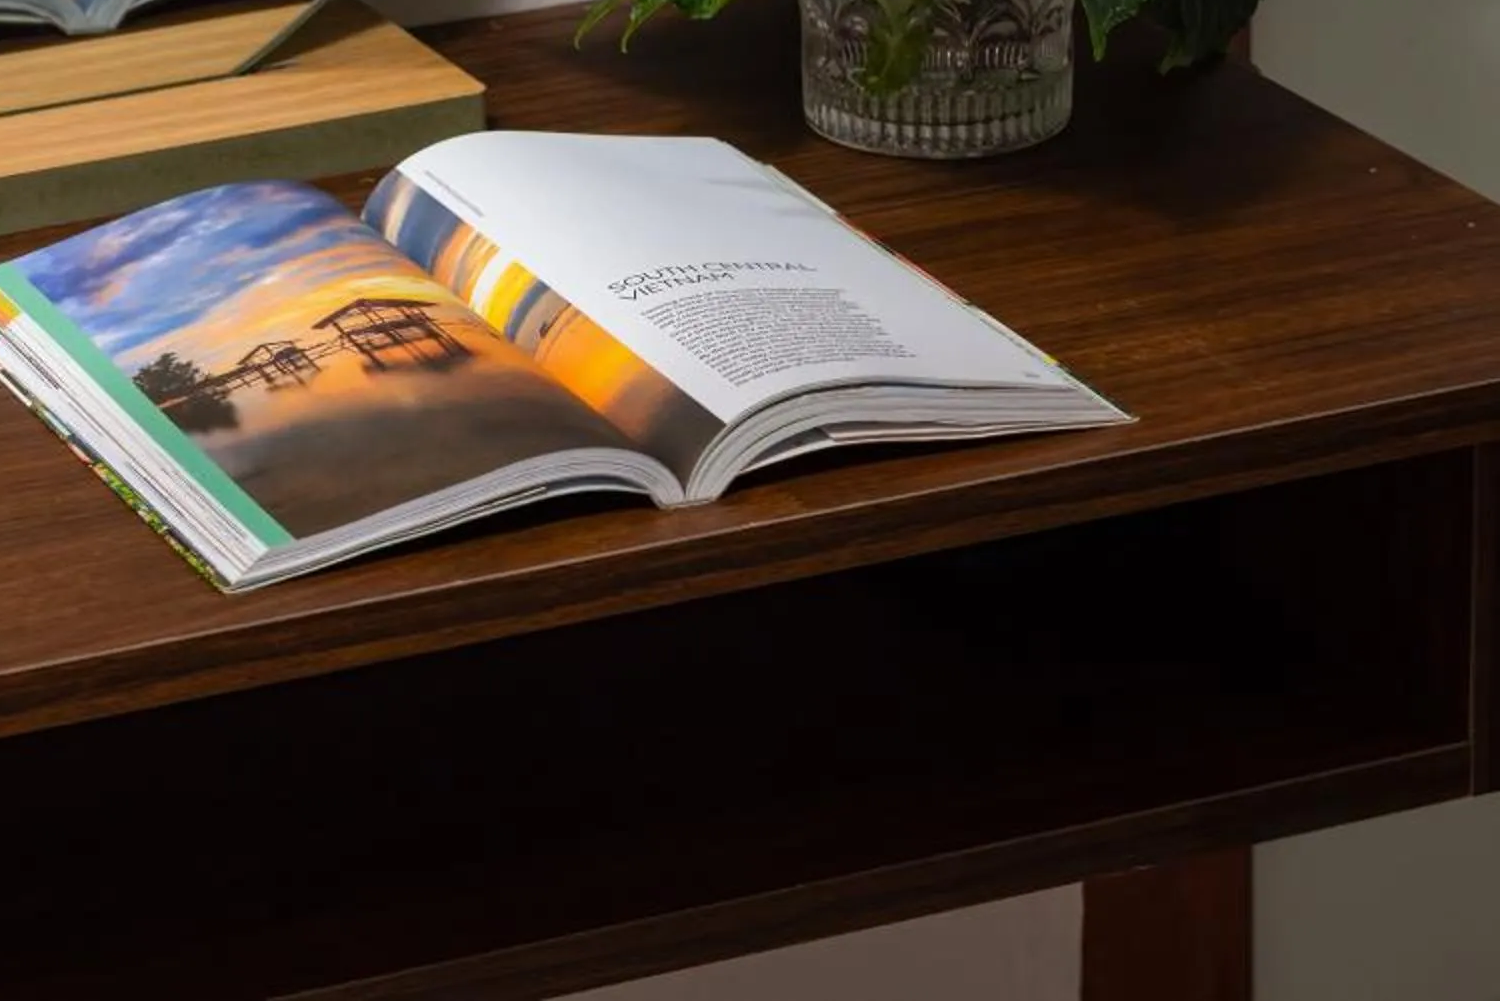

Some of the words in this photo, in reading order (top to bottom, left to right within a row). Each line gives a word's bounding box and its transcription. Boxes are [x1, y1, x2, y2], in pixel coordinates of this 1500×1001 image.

[607, 263, 699, 293] SOUTH
[701, 261, 819, 273] CENTRAL
[618, 271, 736, 300] VIETNAM
